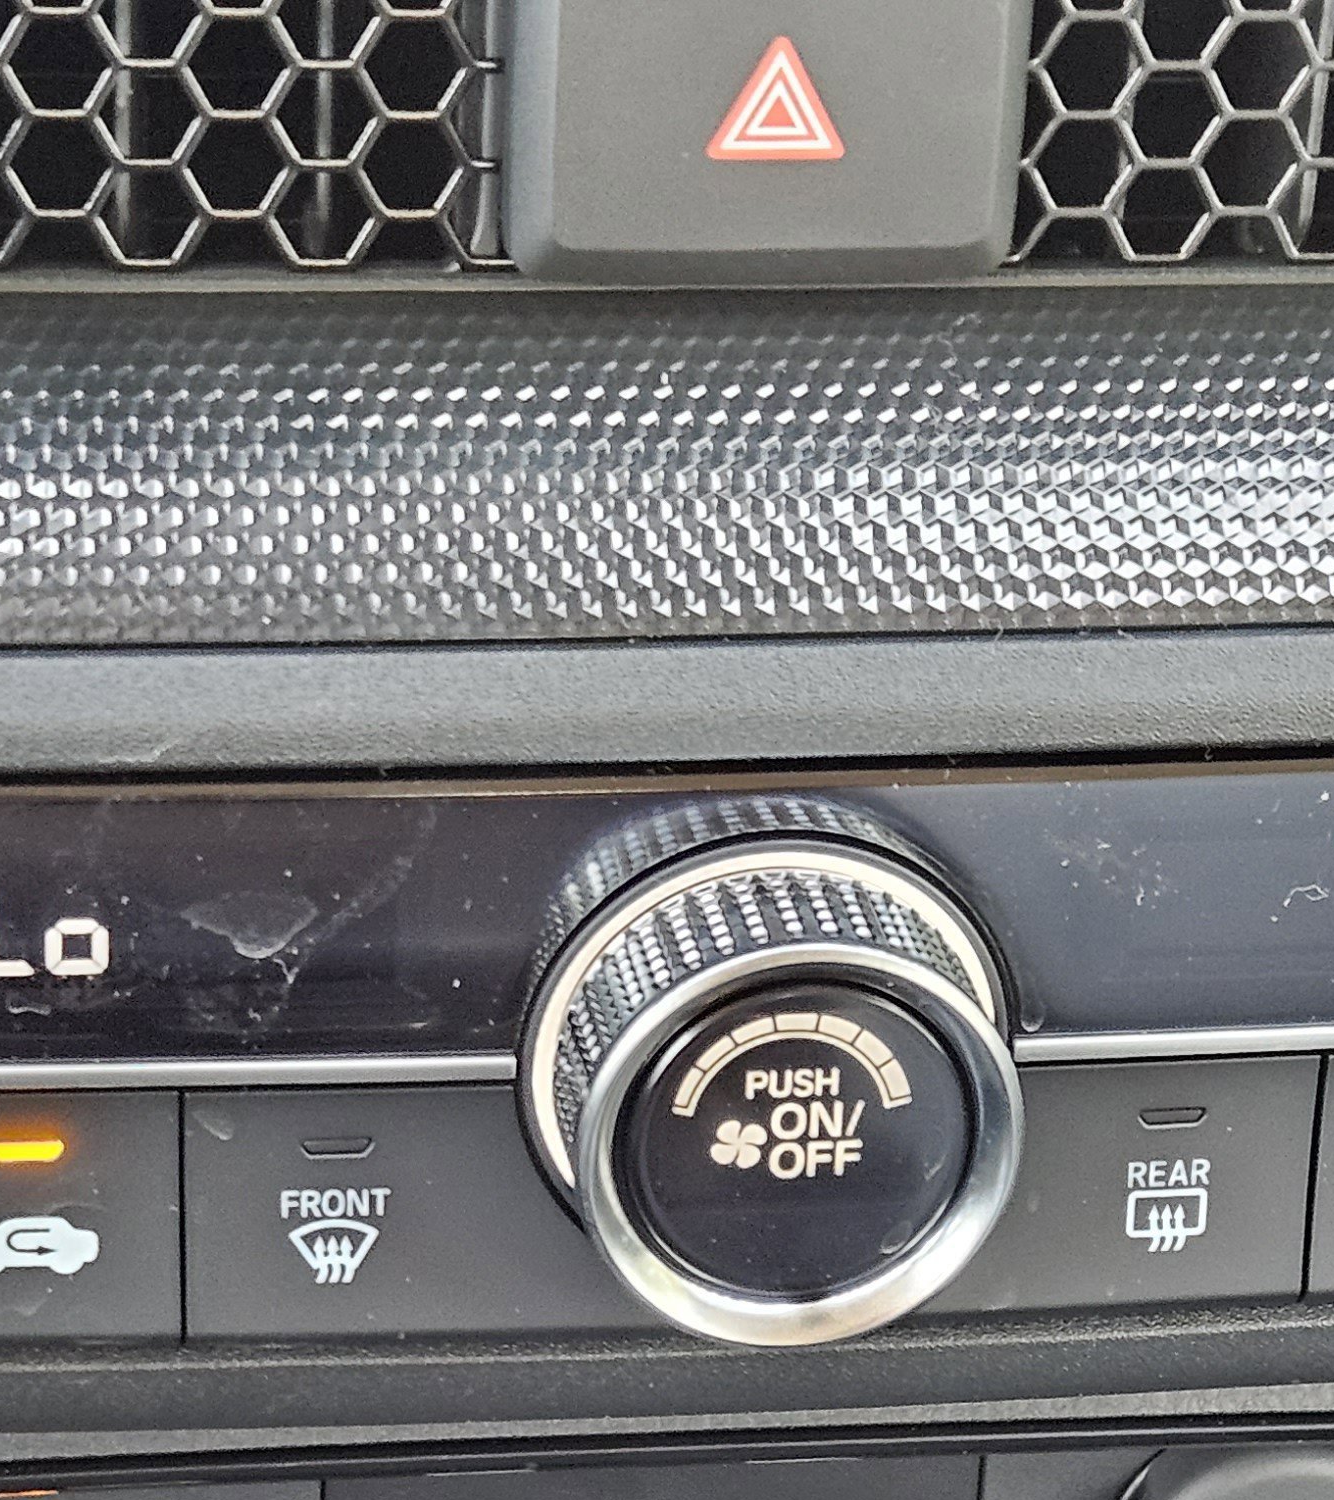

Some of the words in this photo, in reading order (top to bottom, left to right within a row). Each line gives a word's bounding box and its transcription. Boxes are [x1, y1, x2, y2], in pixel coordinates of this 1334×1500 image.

[744, 1066, 841, 1100] PUSH
[770, 1099, 866, 1140] ON/
[768, 1138, 863, 1180] OFF
[1126, 1158, 1211, 1190] REAR
[279, 1187, 392, 1219] FRONT
